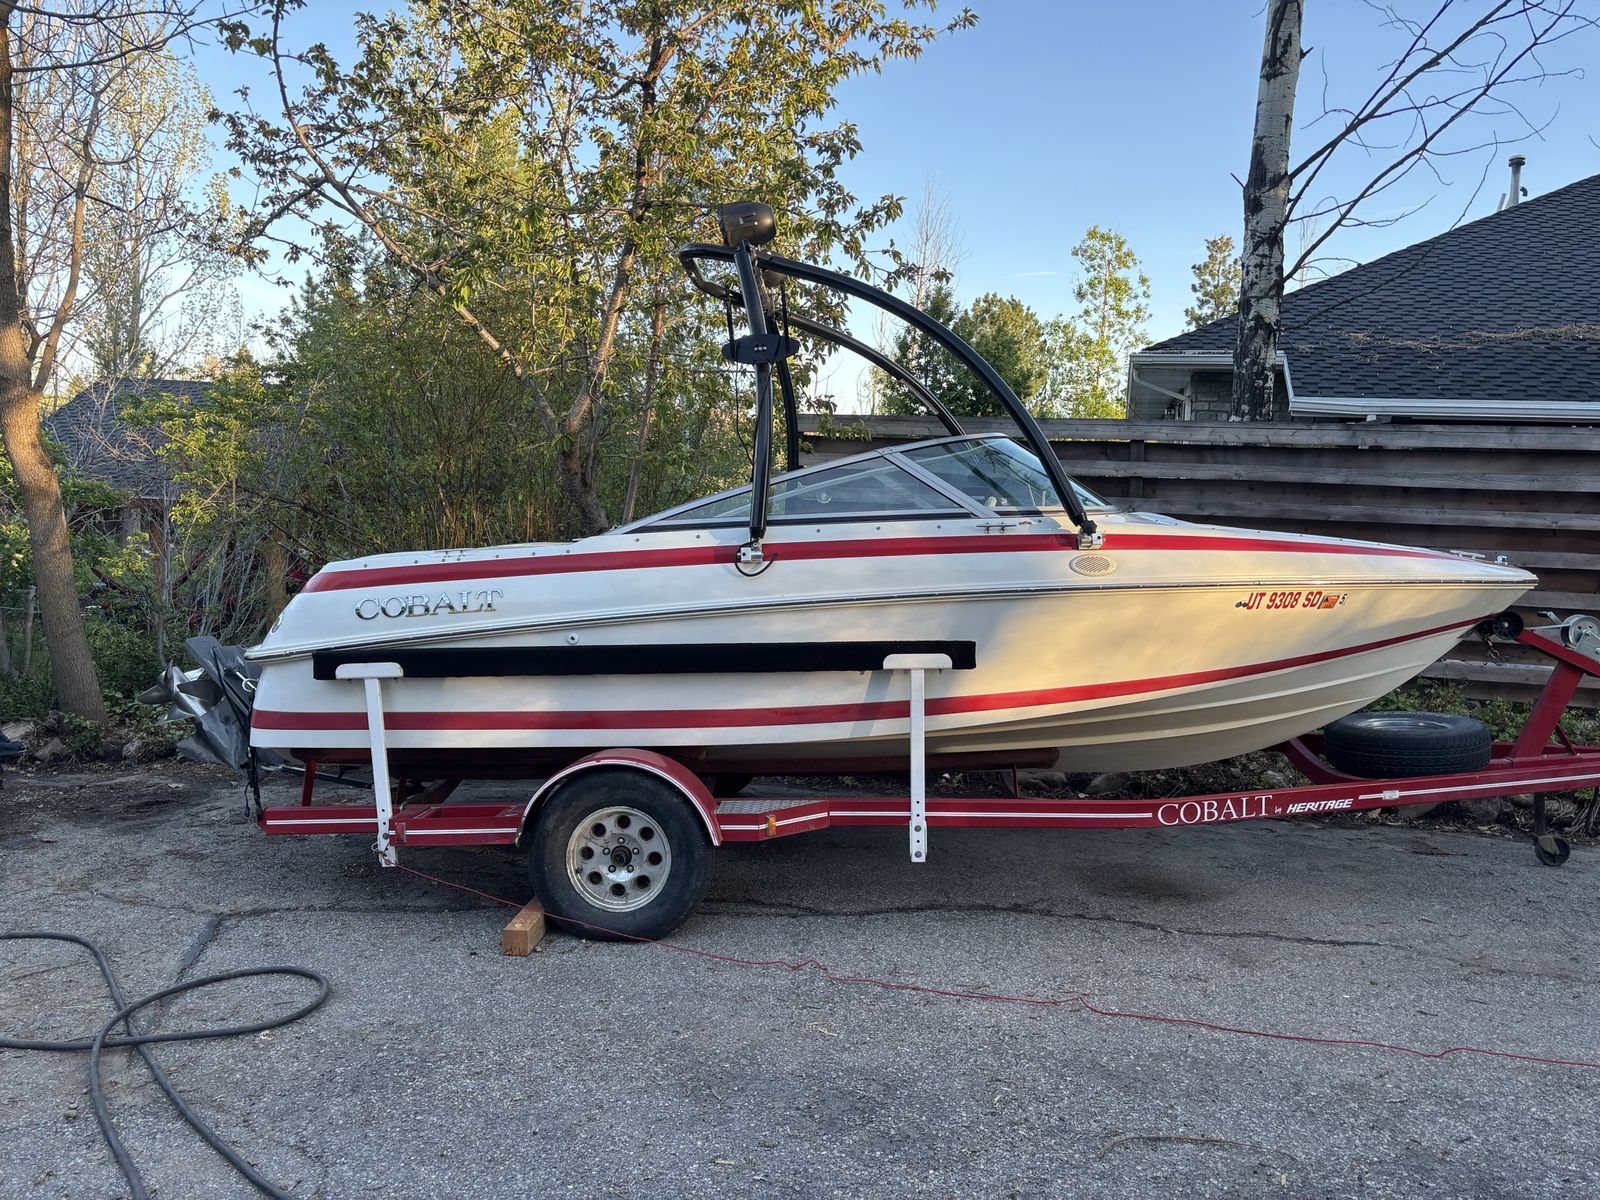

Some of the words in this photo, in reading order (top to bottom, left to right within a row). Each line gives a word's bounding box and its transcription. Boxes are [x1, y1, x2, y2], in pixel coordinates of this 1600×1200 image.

[355, 589, 503, 620] COBALT
[1246, 592, 1266, 609] UT
[1266, 592, 1302, 609] 9308
[1302, 591, 1322, 608] SD
[1157, 795, 1273, 826] COBALT
[1286, 798, 1354, 814] HERITAGE
